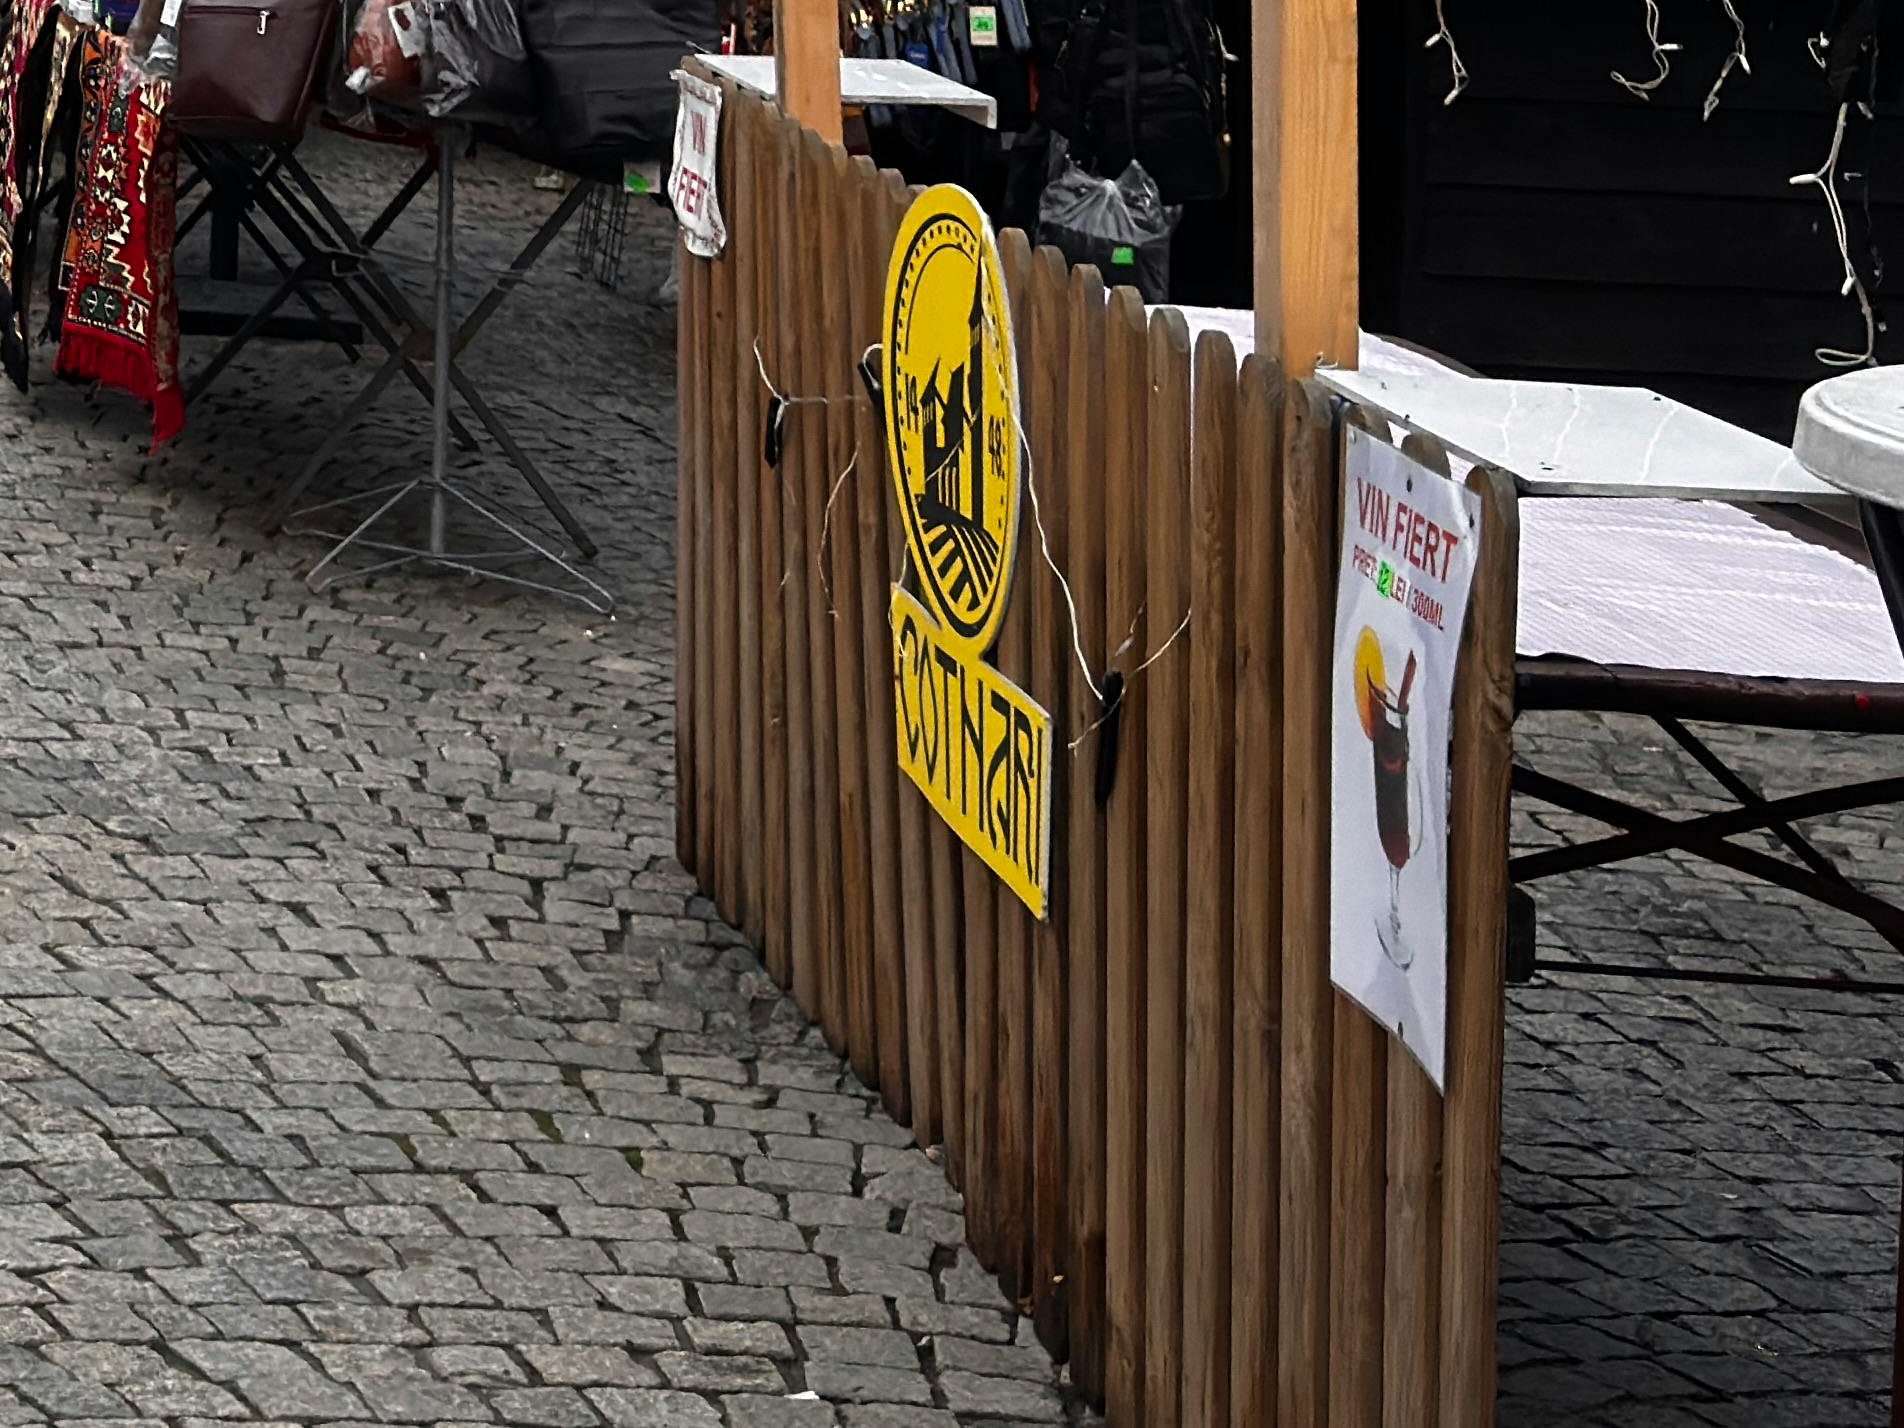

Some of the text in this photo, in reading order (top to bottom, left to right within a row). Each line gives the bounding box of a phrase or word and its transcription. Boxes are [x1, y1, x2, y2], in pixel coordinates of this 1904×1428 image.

[1357, 476, 1459, 584] VIN FIERT
[899, 614, 1043, 885] COTNARI
